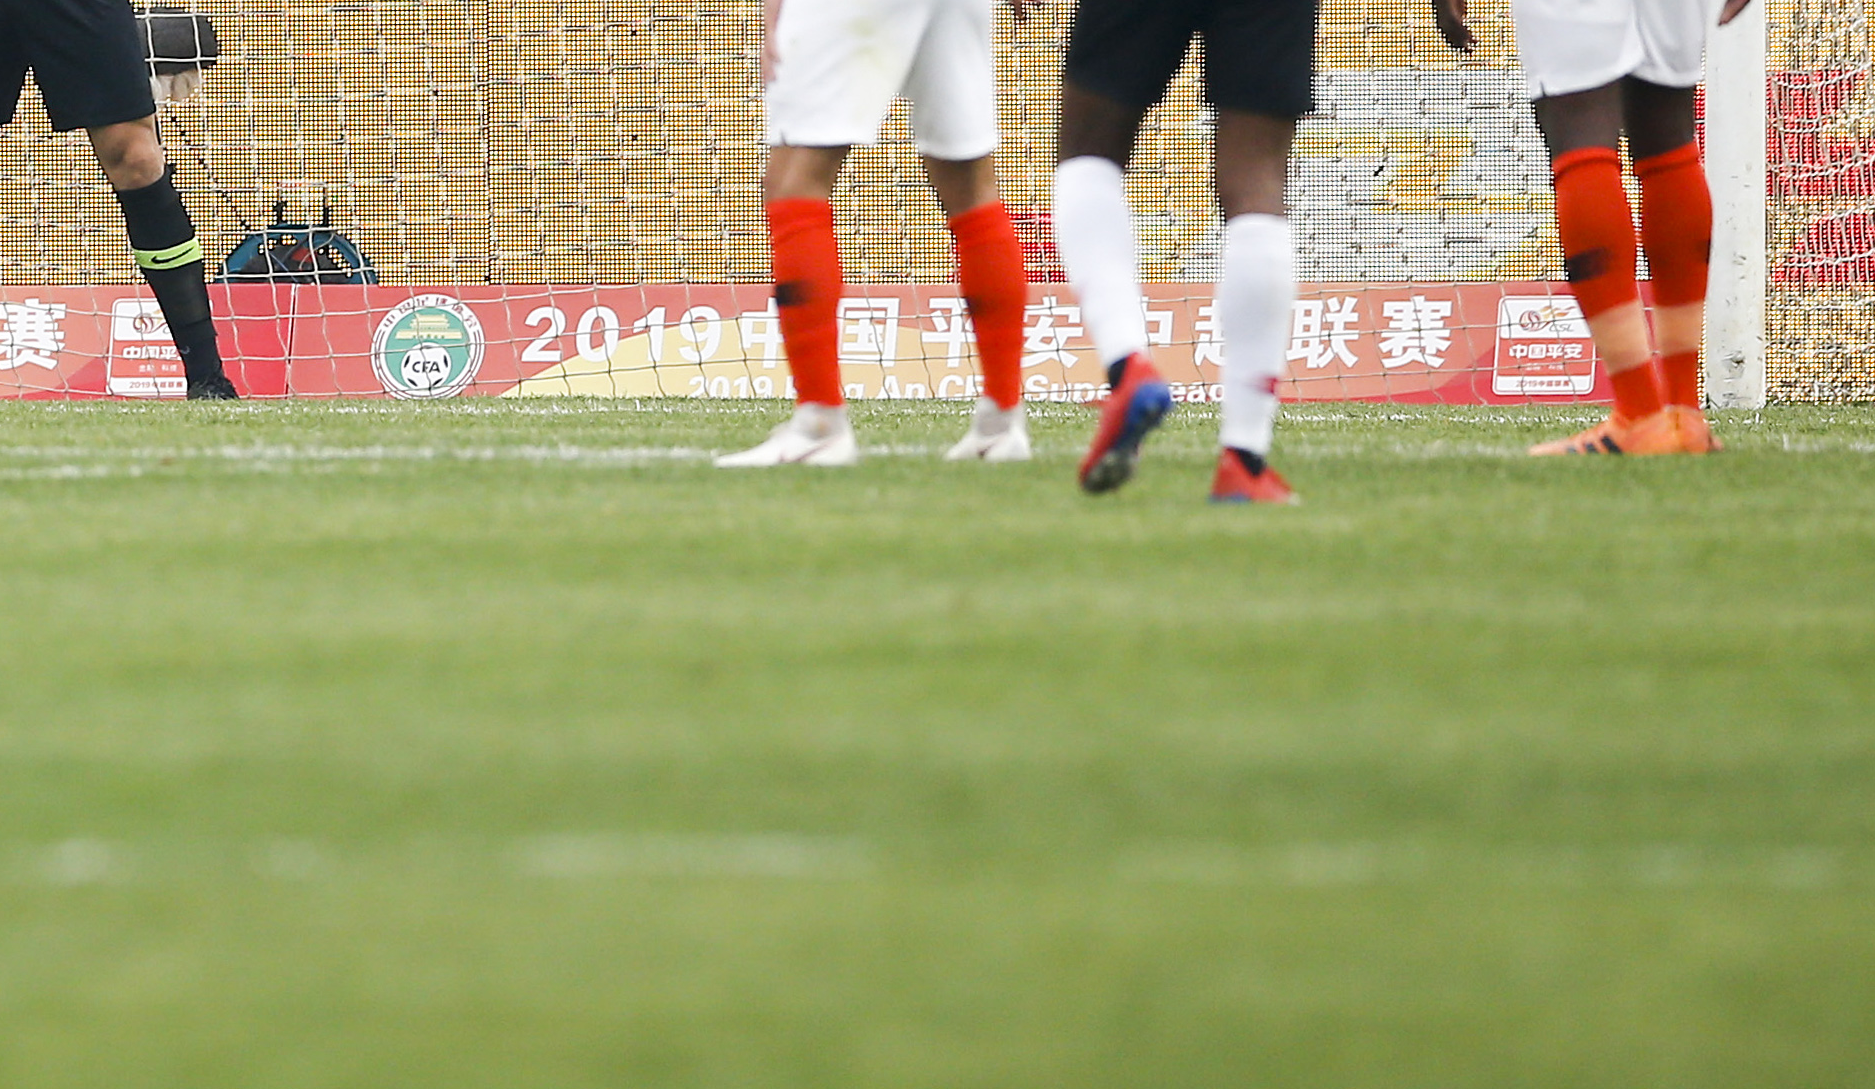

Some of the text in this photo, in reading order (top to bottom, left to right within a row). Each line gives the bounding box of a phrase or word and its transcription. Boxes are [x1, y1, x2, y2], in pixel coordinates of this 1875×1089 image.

[1508, 342, 1583, 359] 中国平安
[412, 361, 441, 373] CFA
[688, 375, 773, 399] 2019
[877, 375, 927, 400] An
[938, 374, 984, 400] CF
